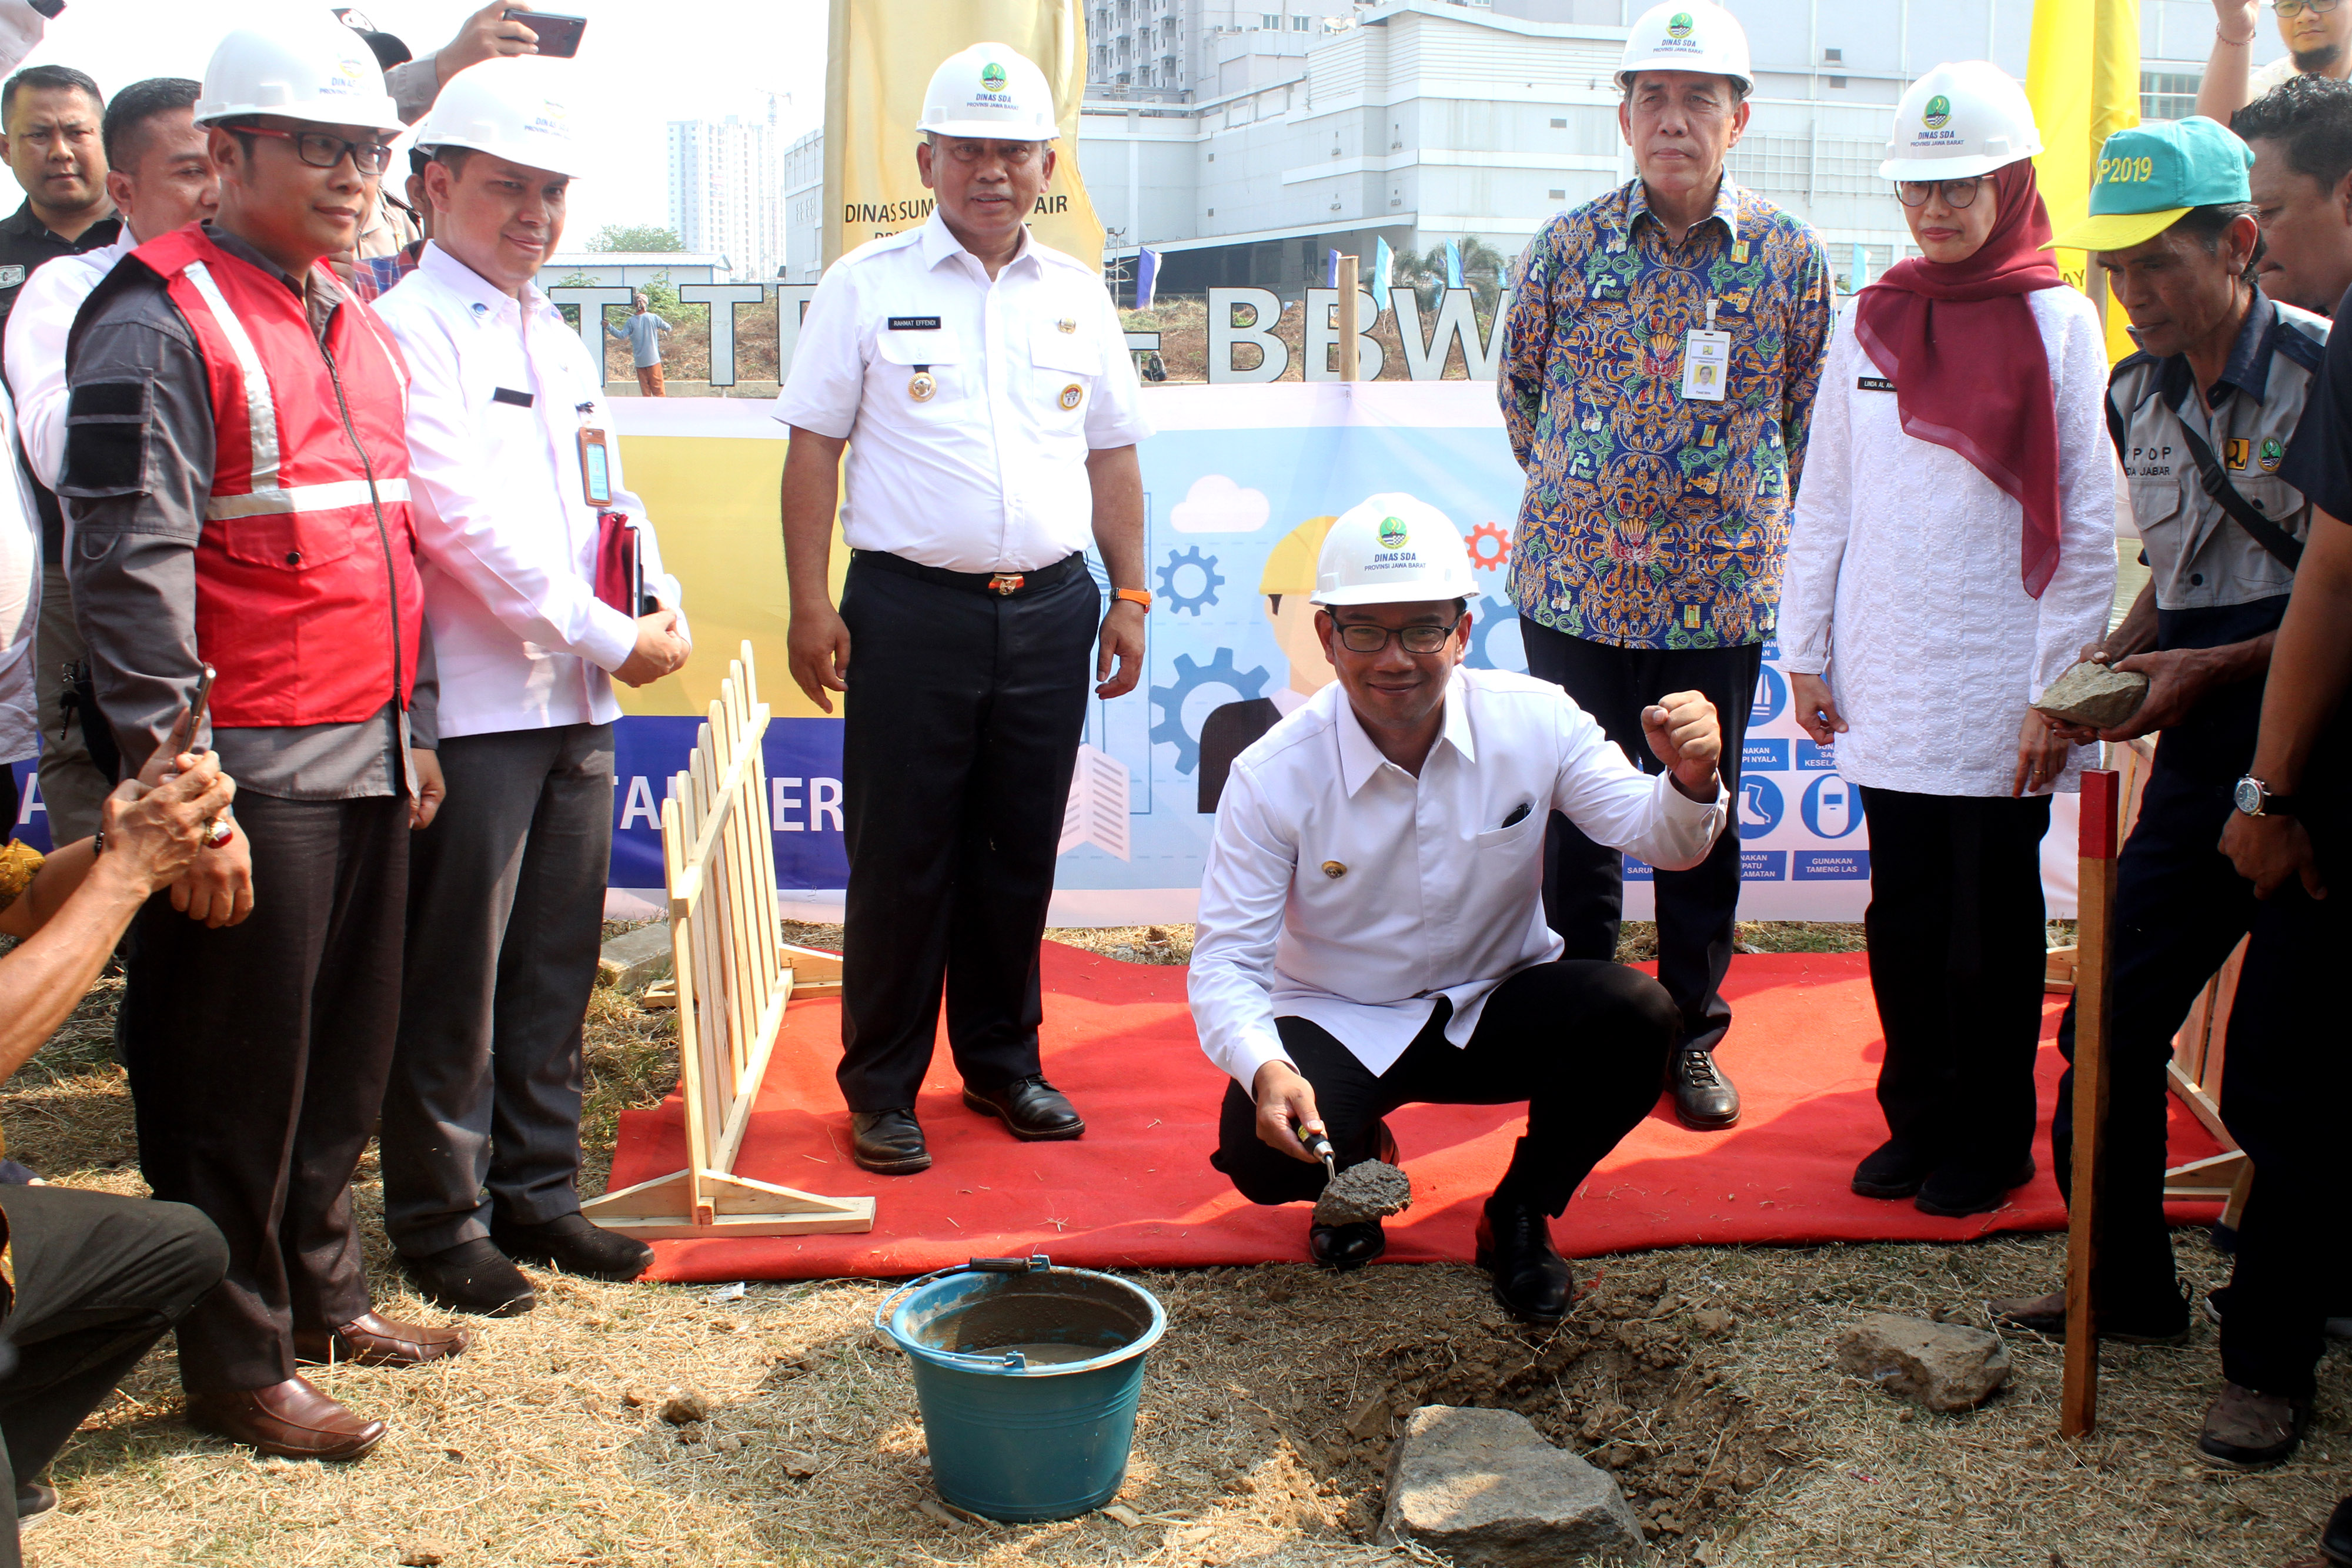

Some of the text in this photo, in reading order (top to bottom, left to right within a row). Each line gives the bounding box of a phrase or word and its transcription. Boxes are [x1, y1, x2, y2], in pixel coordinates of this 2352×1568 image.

[976, 93, 1011, 103] DINAS SDA
[1918, 131, 1955, 139] DINAS SDA
[2095, 156, 2153, 186] P2019
[845, 203, 896, 223] DINAS
[1034, 195, 1067, 214] AIR
[2125, 447, 2171, 461] POP
[2140, 466, 2170, 476] JABAR
[1374, 553, 1416, 563] DINAS SDA
[1364, 563, 1390, 571] PROVINSI
